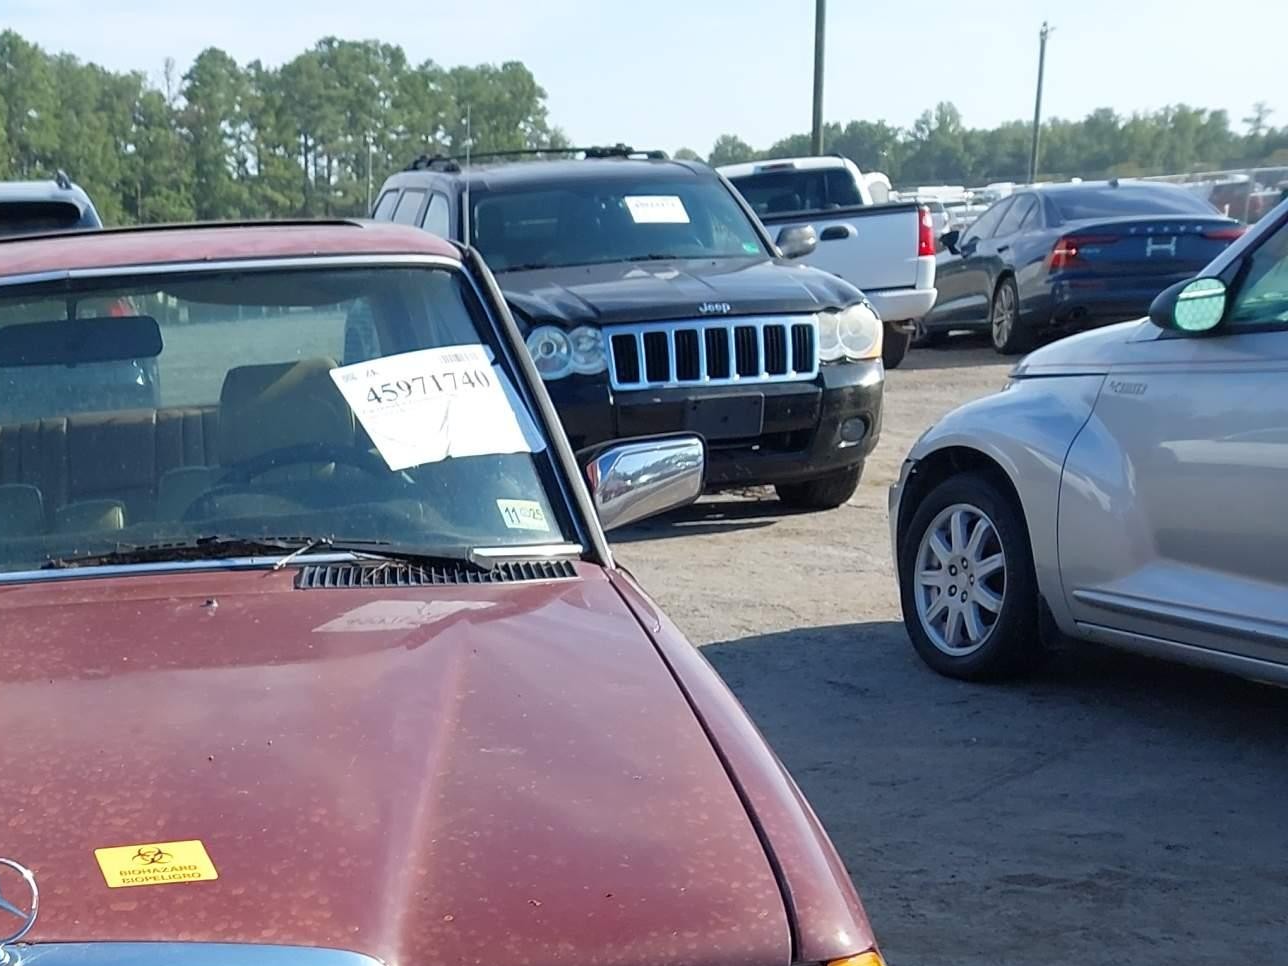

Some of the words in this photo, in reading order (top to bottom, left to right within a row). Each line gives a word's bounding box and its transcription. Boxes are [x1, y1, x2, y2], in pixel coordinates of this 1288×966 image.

[698, 302, 731, 314] Jeep
[367, 369, 490, 403] 45971740
[505, 506, 520, 523] 11
[119, 864, 198, 876] BIOHAZARD
[122, 872, 202, 884] BIOPELIGRO
